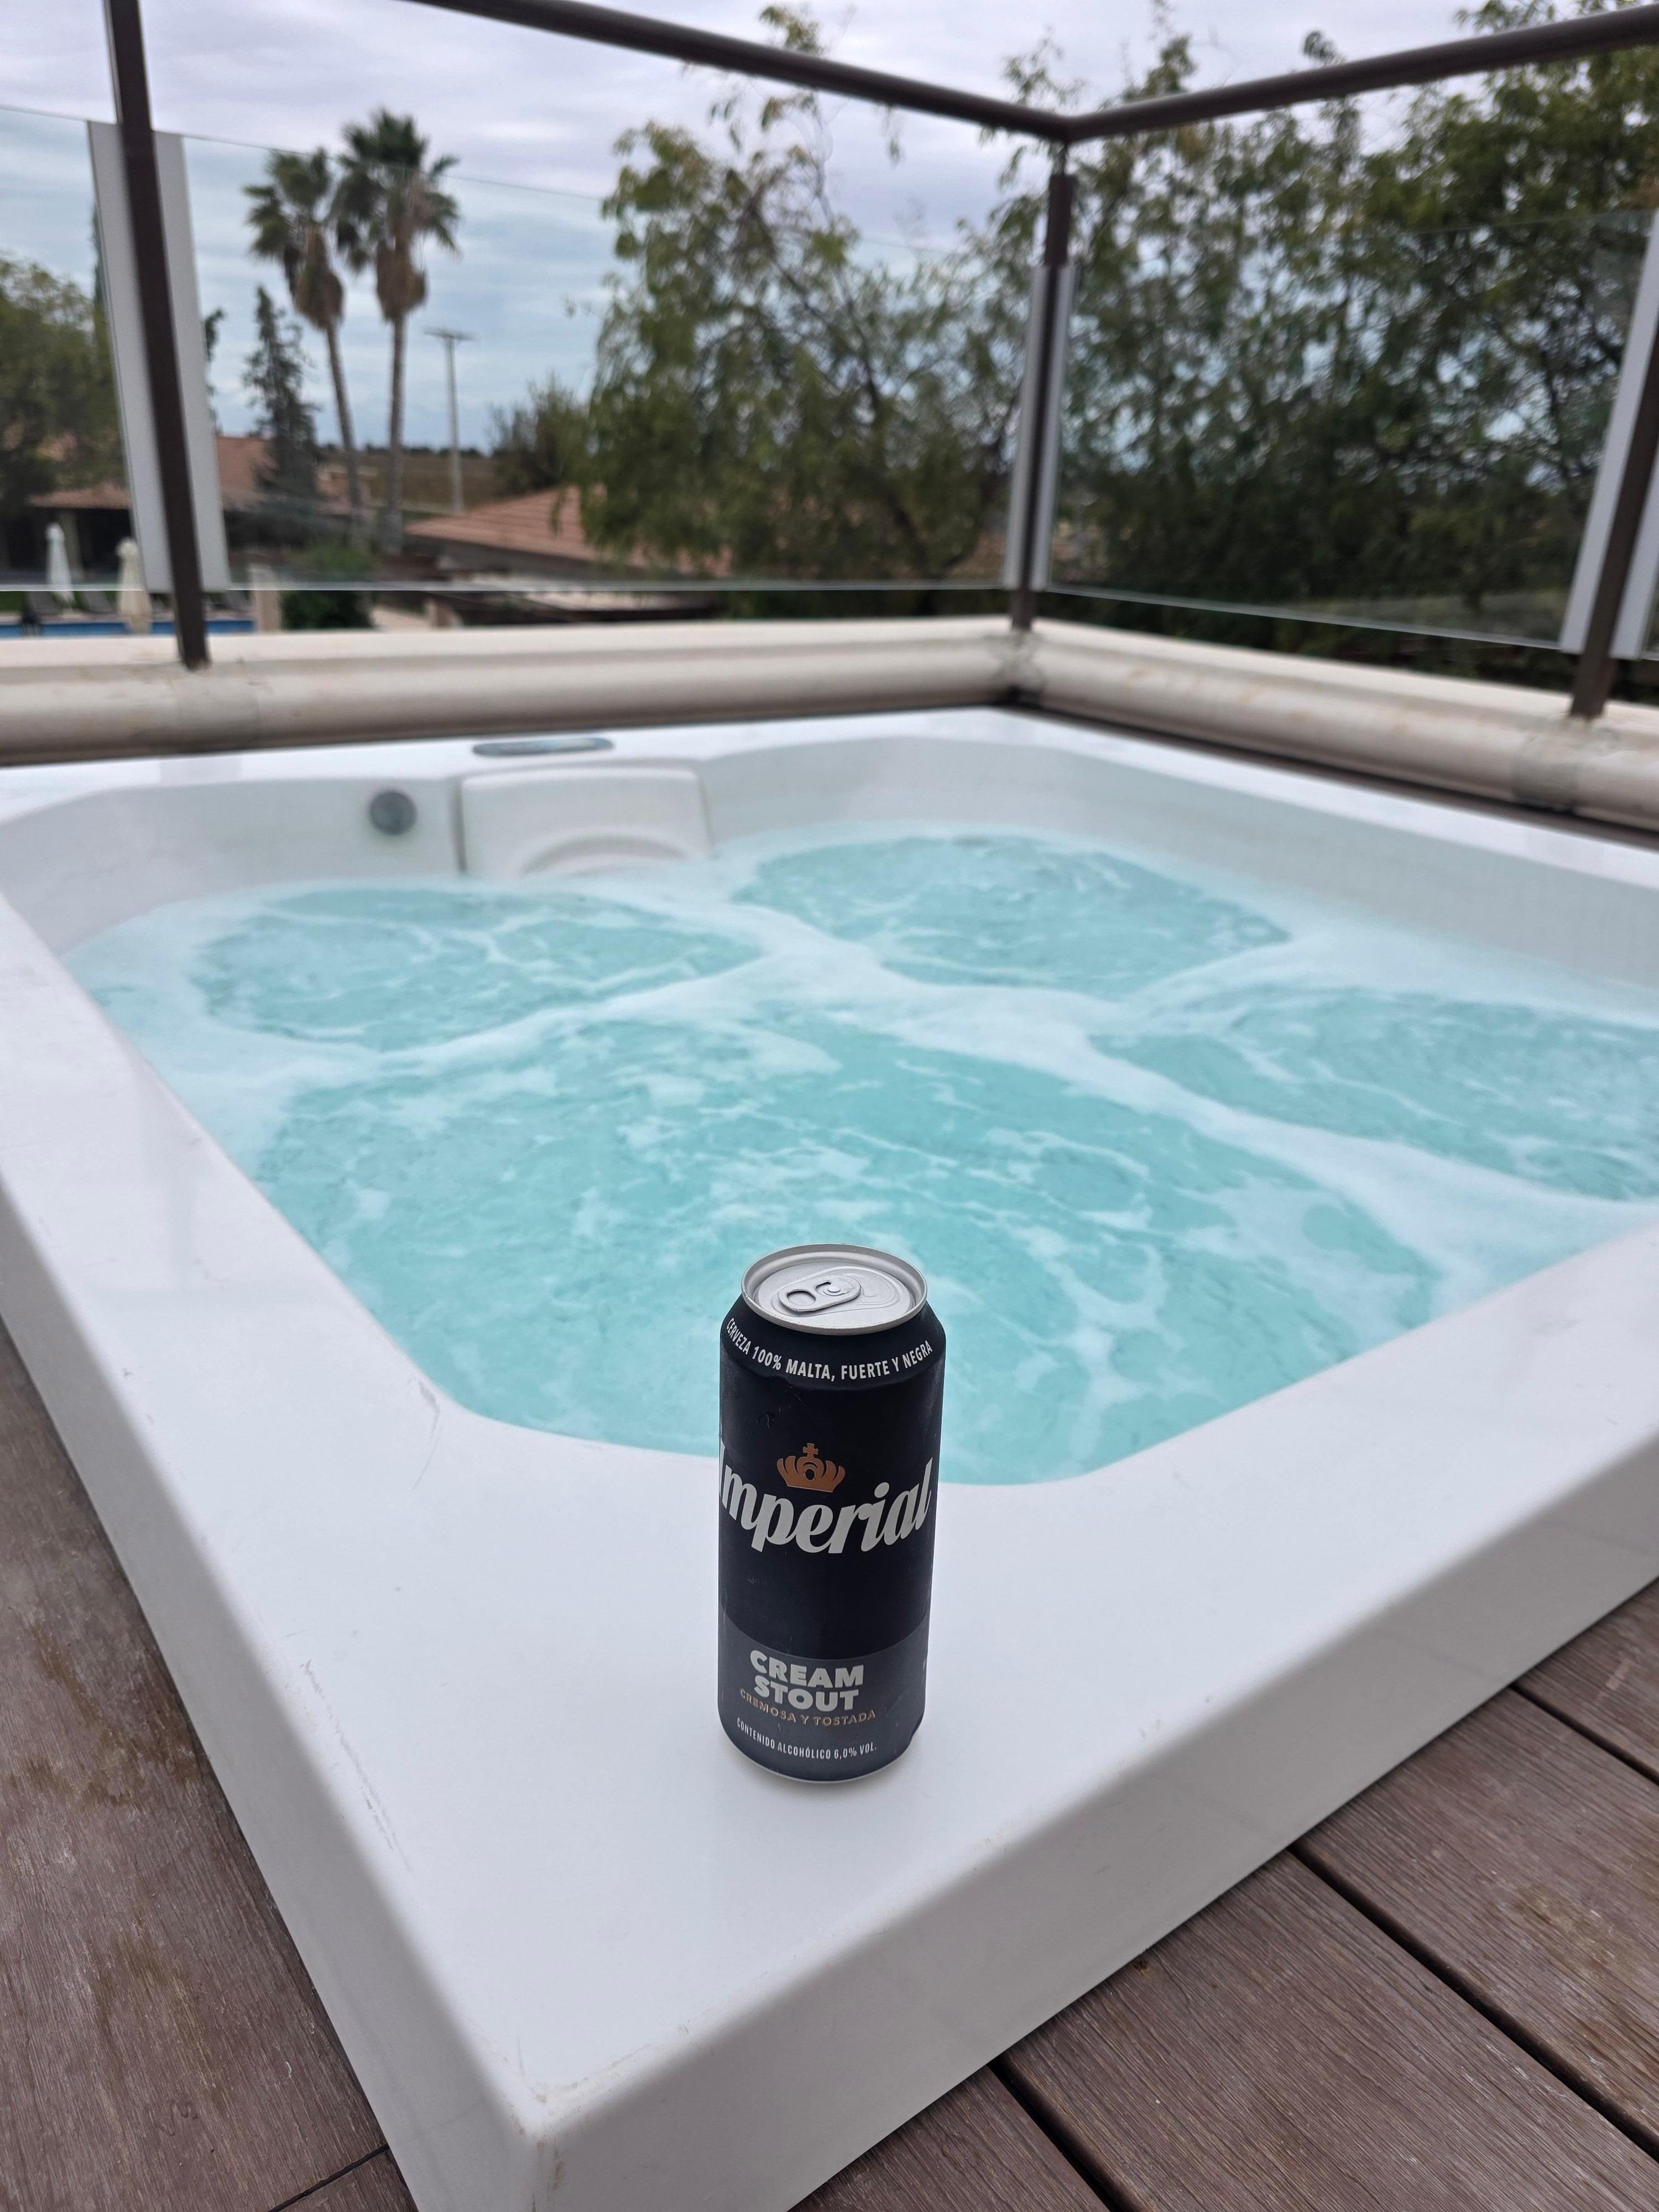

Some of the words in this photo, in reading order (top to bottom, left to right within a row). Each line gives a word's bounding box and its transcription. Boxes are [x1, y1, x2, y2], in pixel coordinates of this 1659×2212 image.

[726, 1318, 751, 1355] CERVEZA
[752, 1346, 781, 1370] 100%
[786, 1359, 835, 1381] MALTA,
[841, 1360, 890, 1380] FUERTE
[891, 1358, 900, 1373] Y
[902, 1340, 933, 1368] NEGRA
[750, 1650, 864, 1688] CREAM
[739, 1688, 796, 1724] CREMOSA
[800, 1715, 810, 1725] Y
[813, 1709, 877, 1726] TOSTADA
[754, 1675, 859, 1712] STOUT
[737, 1717, 775, 1749] CONTENIDO
[778, 1742, 831, 1760] ALCOHÓLICO
[834, 1747, 857, 1760] 6,0%
[859, 1741, 877, 1755] VOL.
